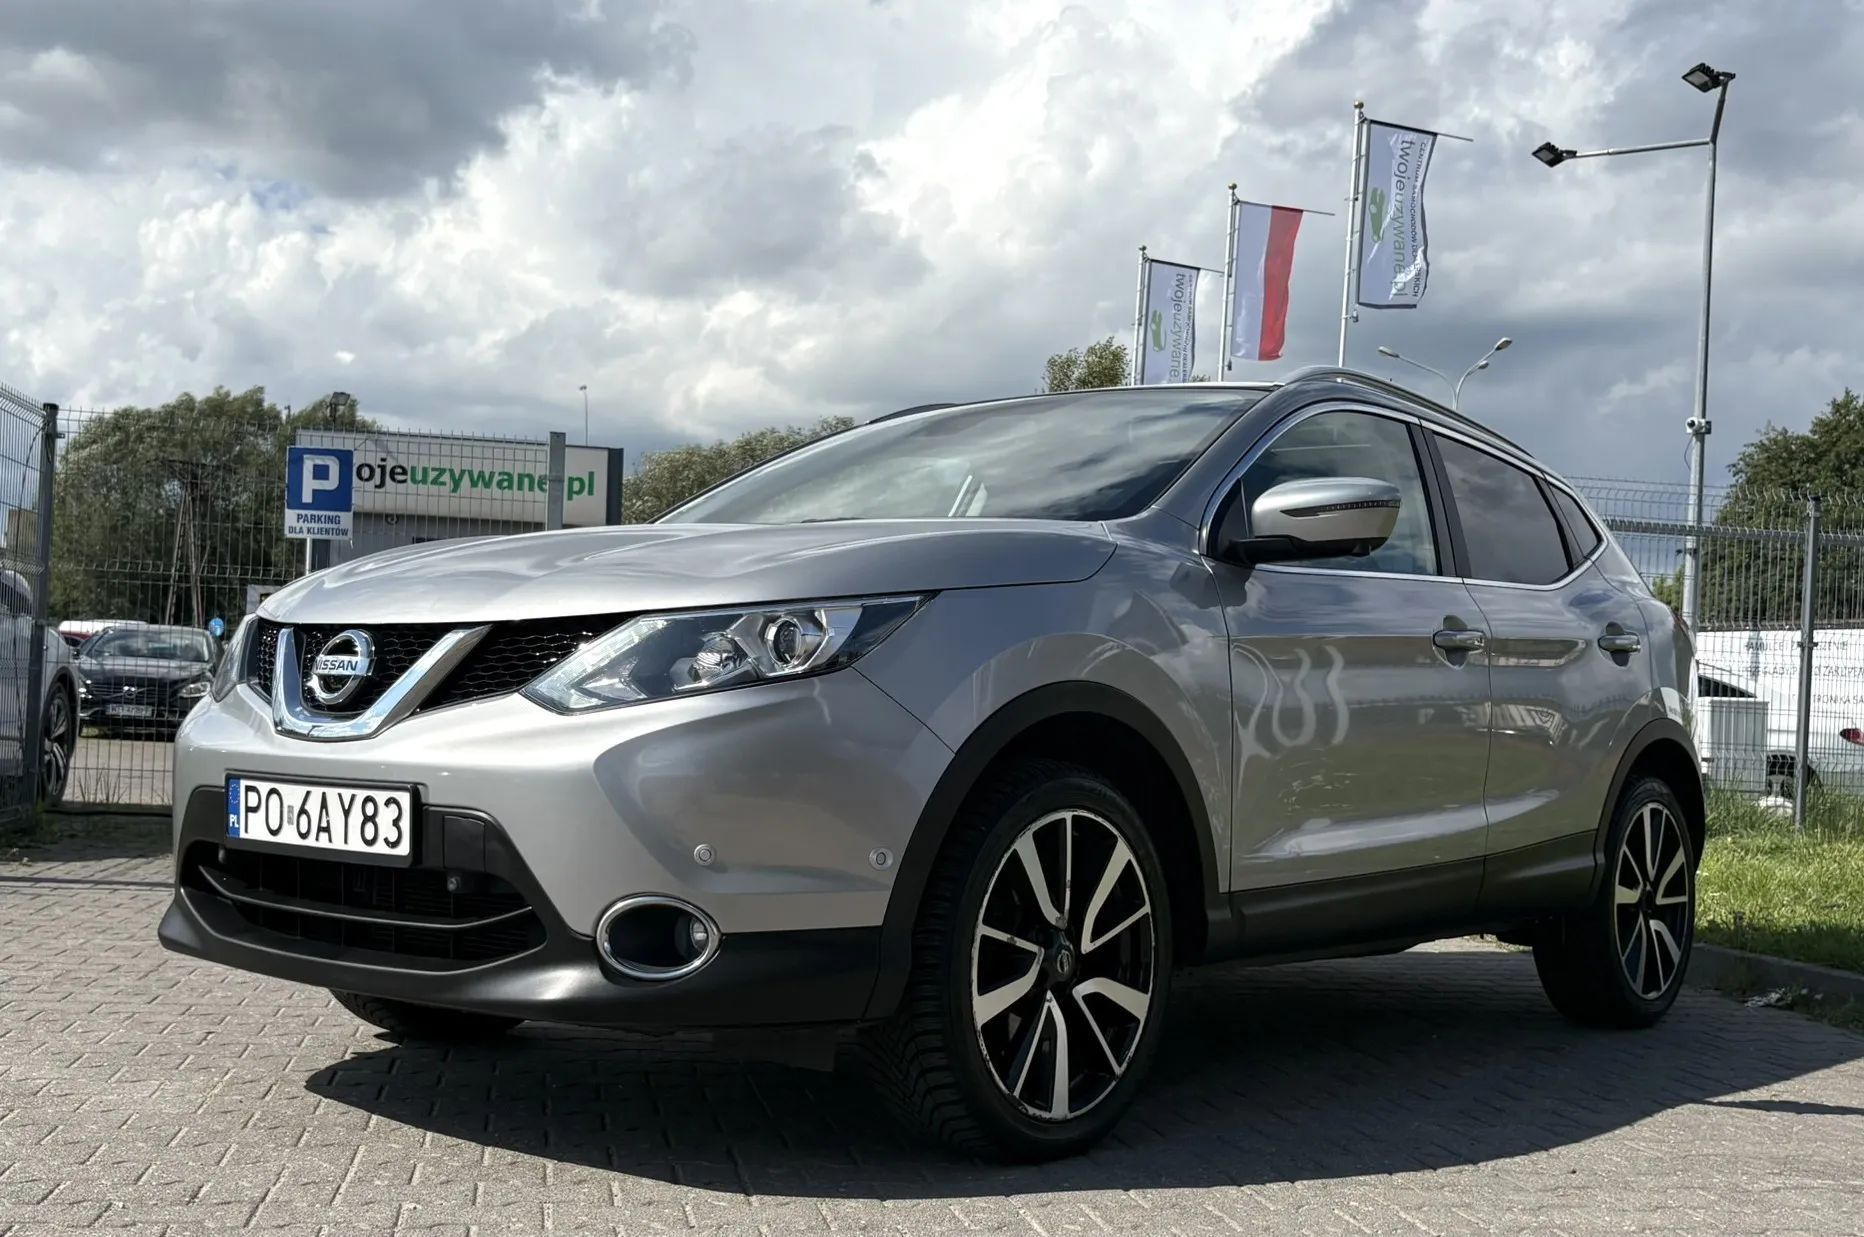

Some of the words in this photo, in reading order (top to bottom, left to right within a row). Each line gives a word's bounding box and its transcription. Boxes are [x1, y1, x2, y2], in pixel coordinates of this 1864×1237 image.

[302, 454, 339, 504] P
[356, 457, 595, 501] ojeuzywanepl
[288, 525, 304, 535] DLA
[307, 526, 349, 537] KLIENTÓW
[296, 513, 342, 525] PARKING
[315, 660, 359, 672] NISSAN
[229, 813, 239, 828] PL
[296, 790, 403, 849] 6AY83
